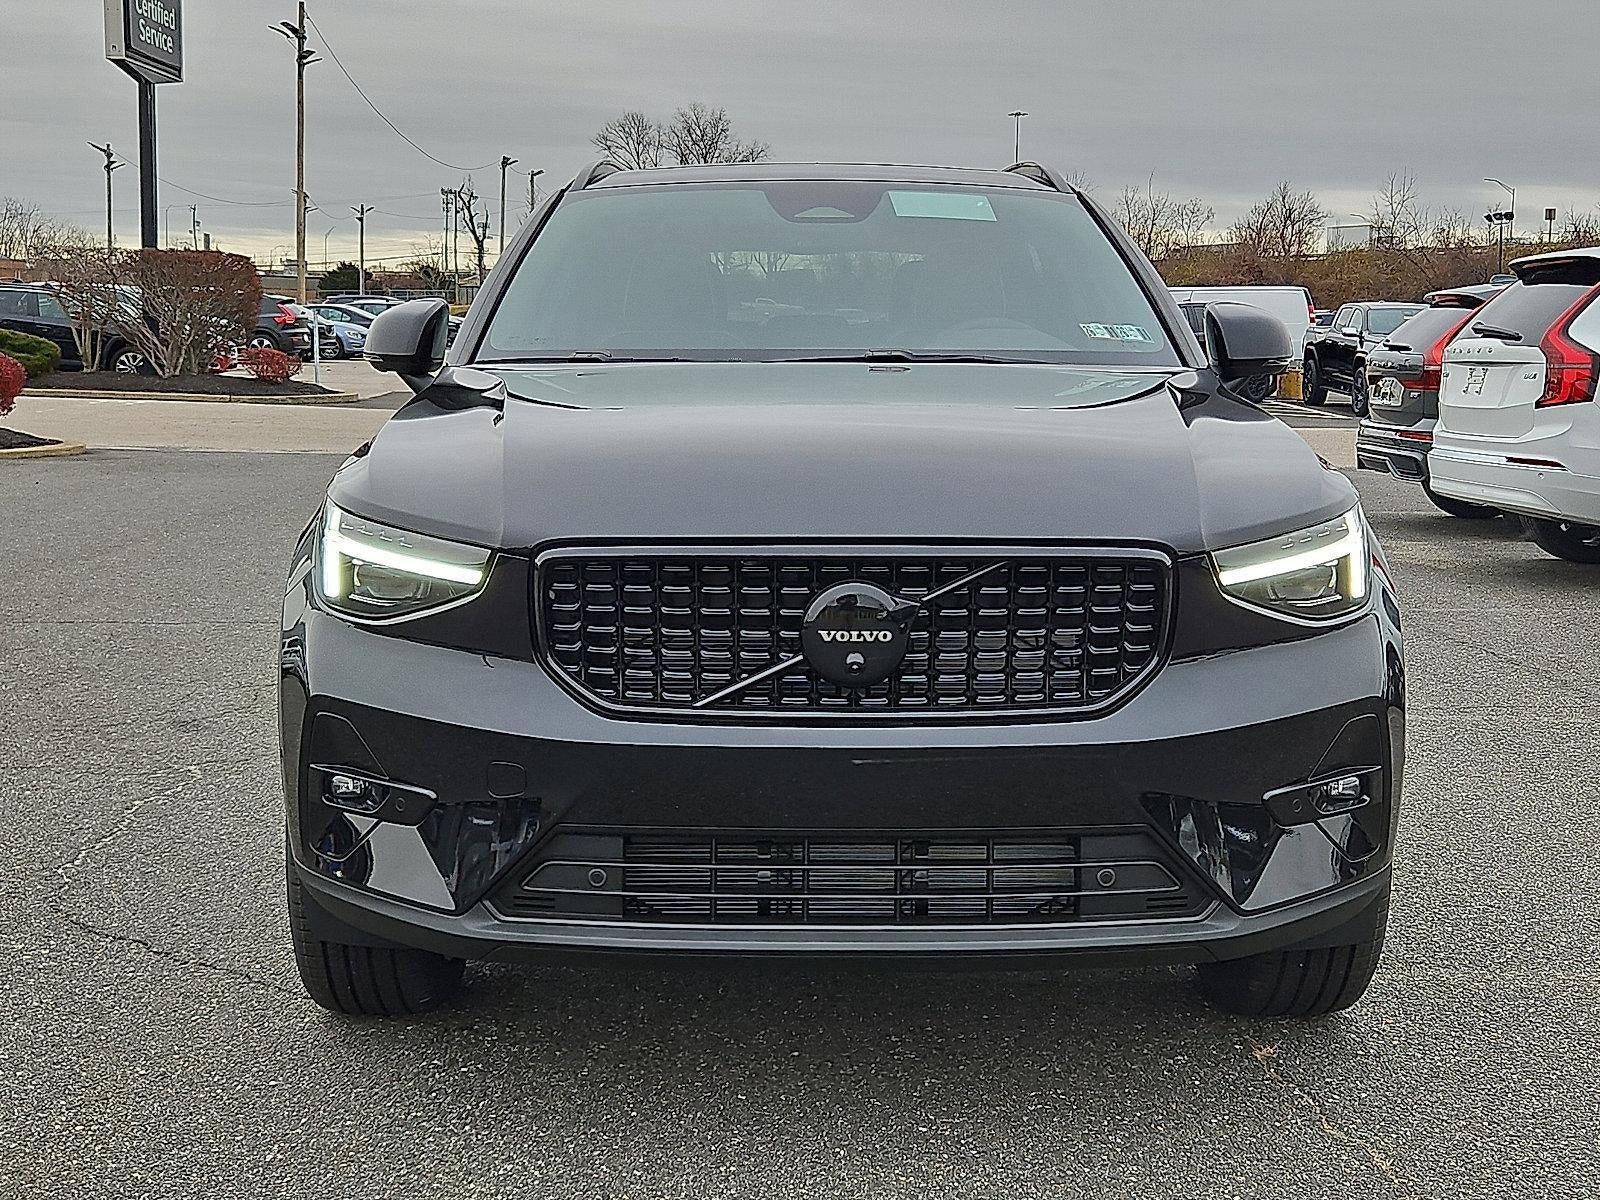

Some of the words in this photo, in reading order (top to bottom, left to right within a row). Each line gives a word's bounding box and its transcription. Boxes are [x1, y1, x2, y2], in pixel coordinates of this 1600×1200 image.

[135, 0, 176, 30] Certified
[139, 18, 173, 53] Service
[818, 630, 893, 642] VOLVO
